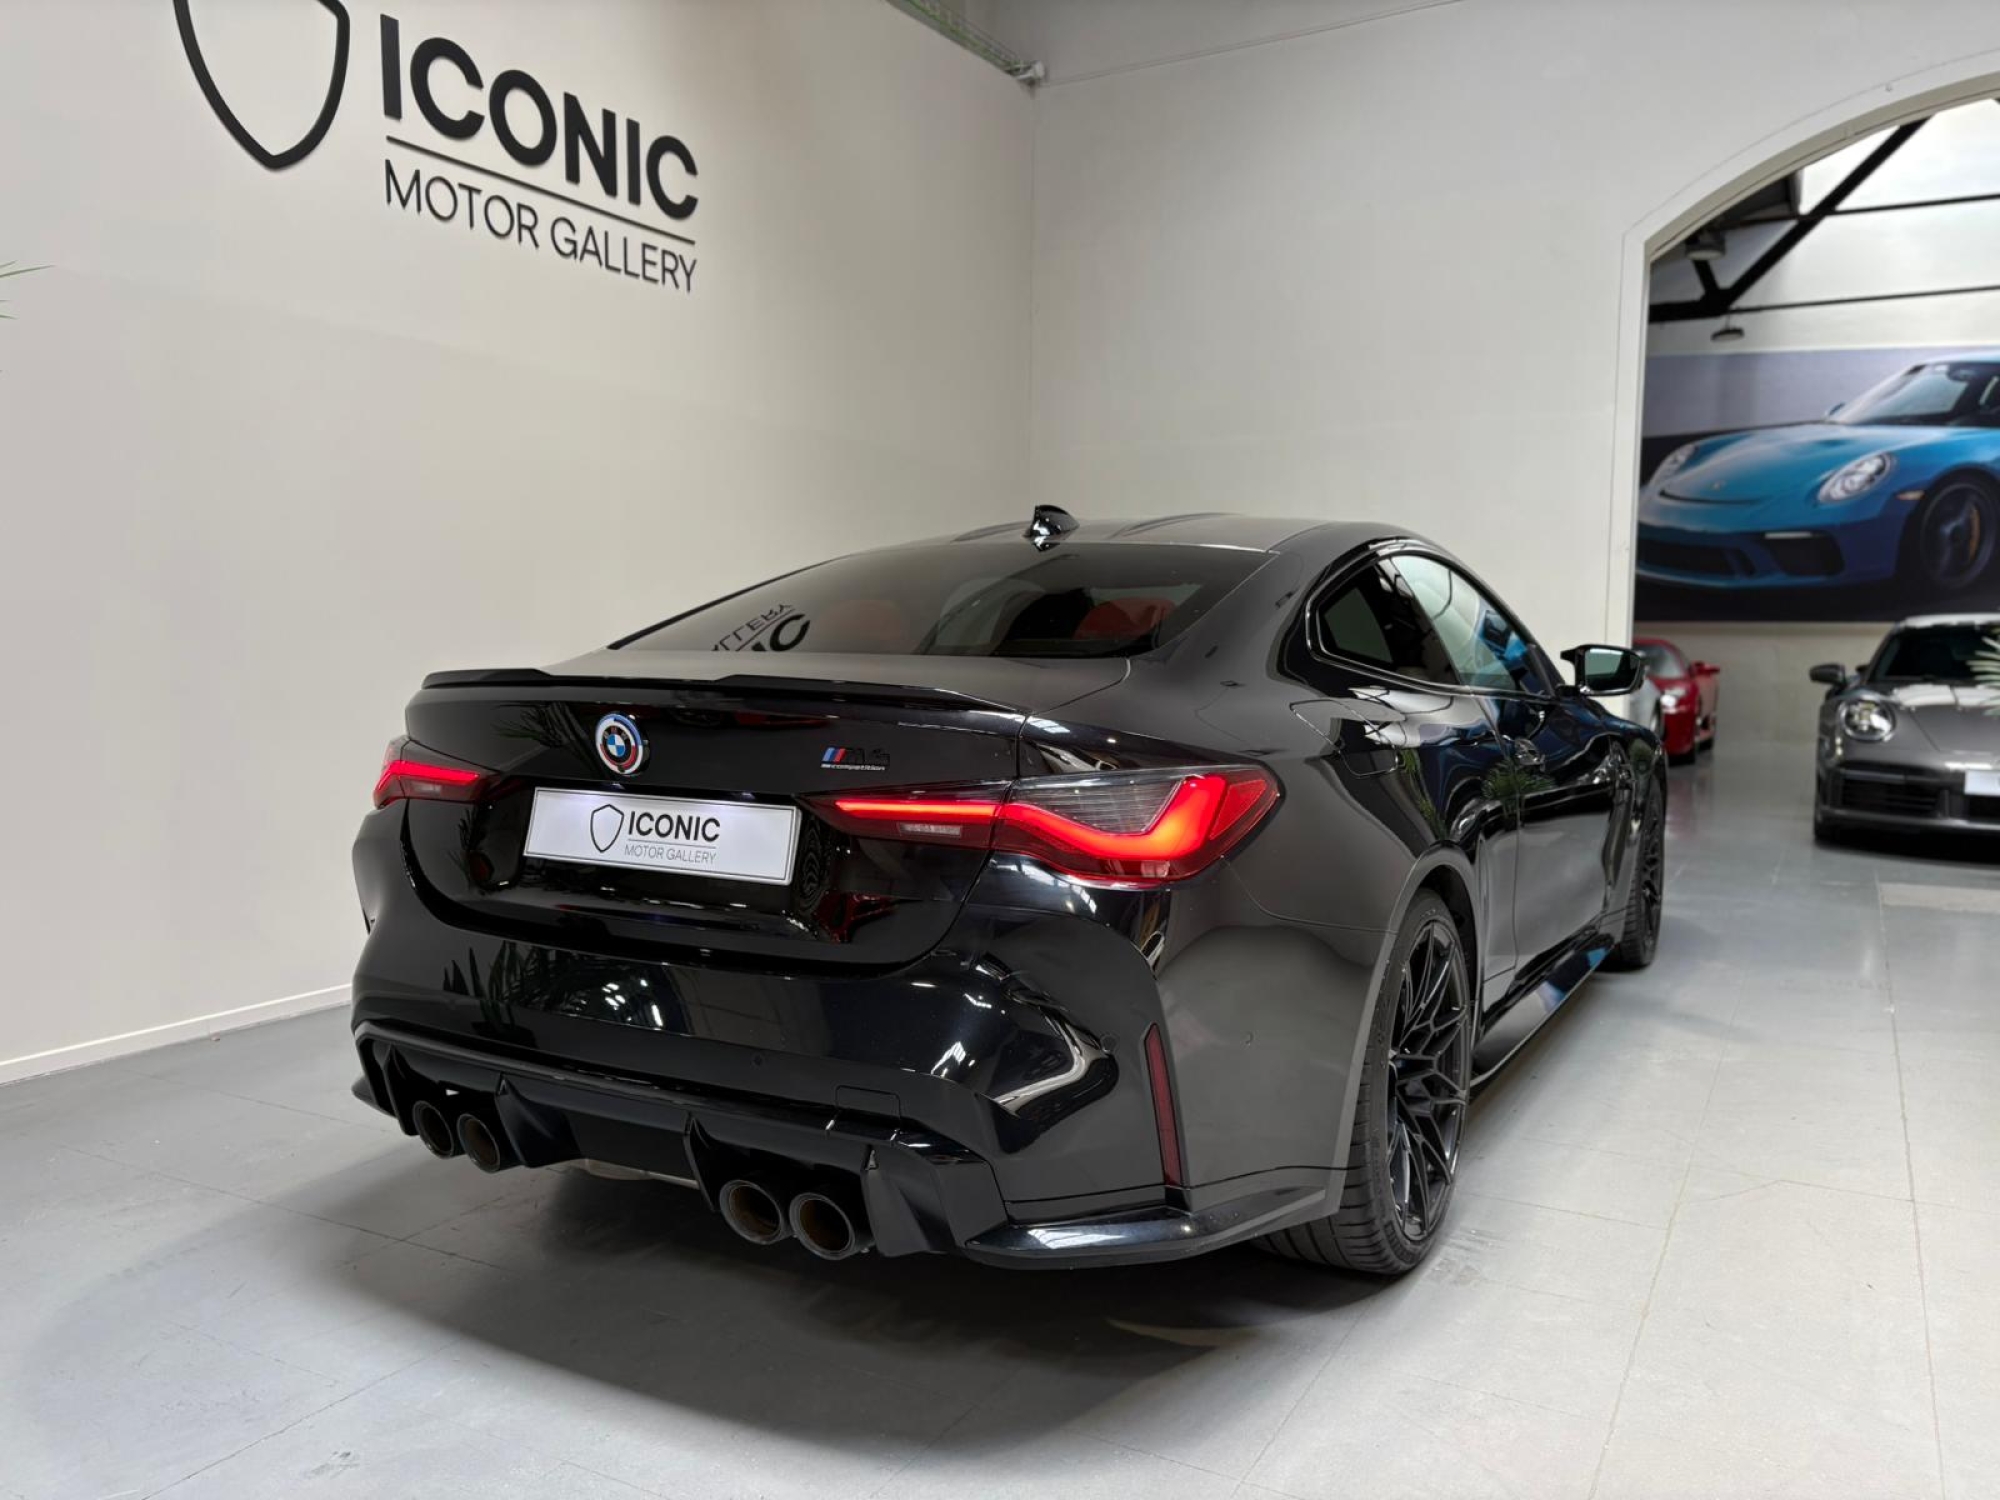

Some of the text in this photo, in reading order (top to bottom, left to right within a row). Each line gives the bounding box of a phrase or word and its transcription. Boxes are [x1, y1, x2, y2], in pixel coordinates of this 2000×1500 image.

[380, 13, 698, 221] ICONIC
[385, 158, 697, 293] MOTOR GALLERY
[624, 844, 717, 864] MOTOR GALLERY
[628, 811, 720, 842] ICONIC
